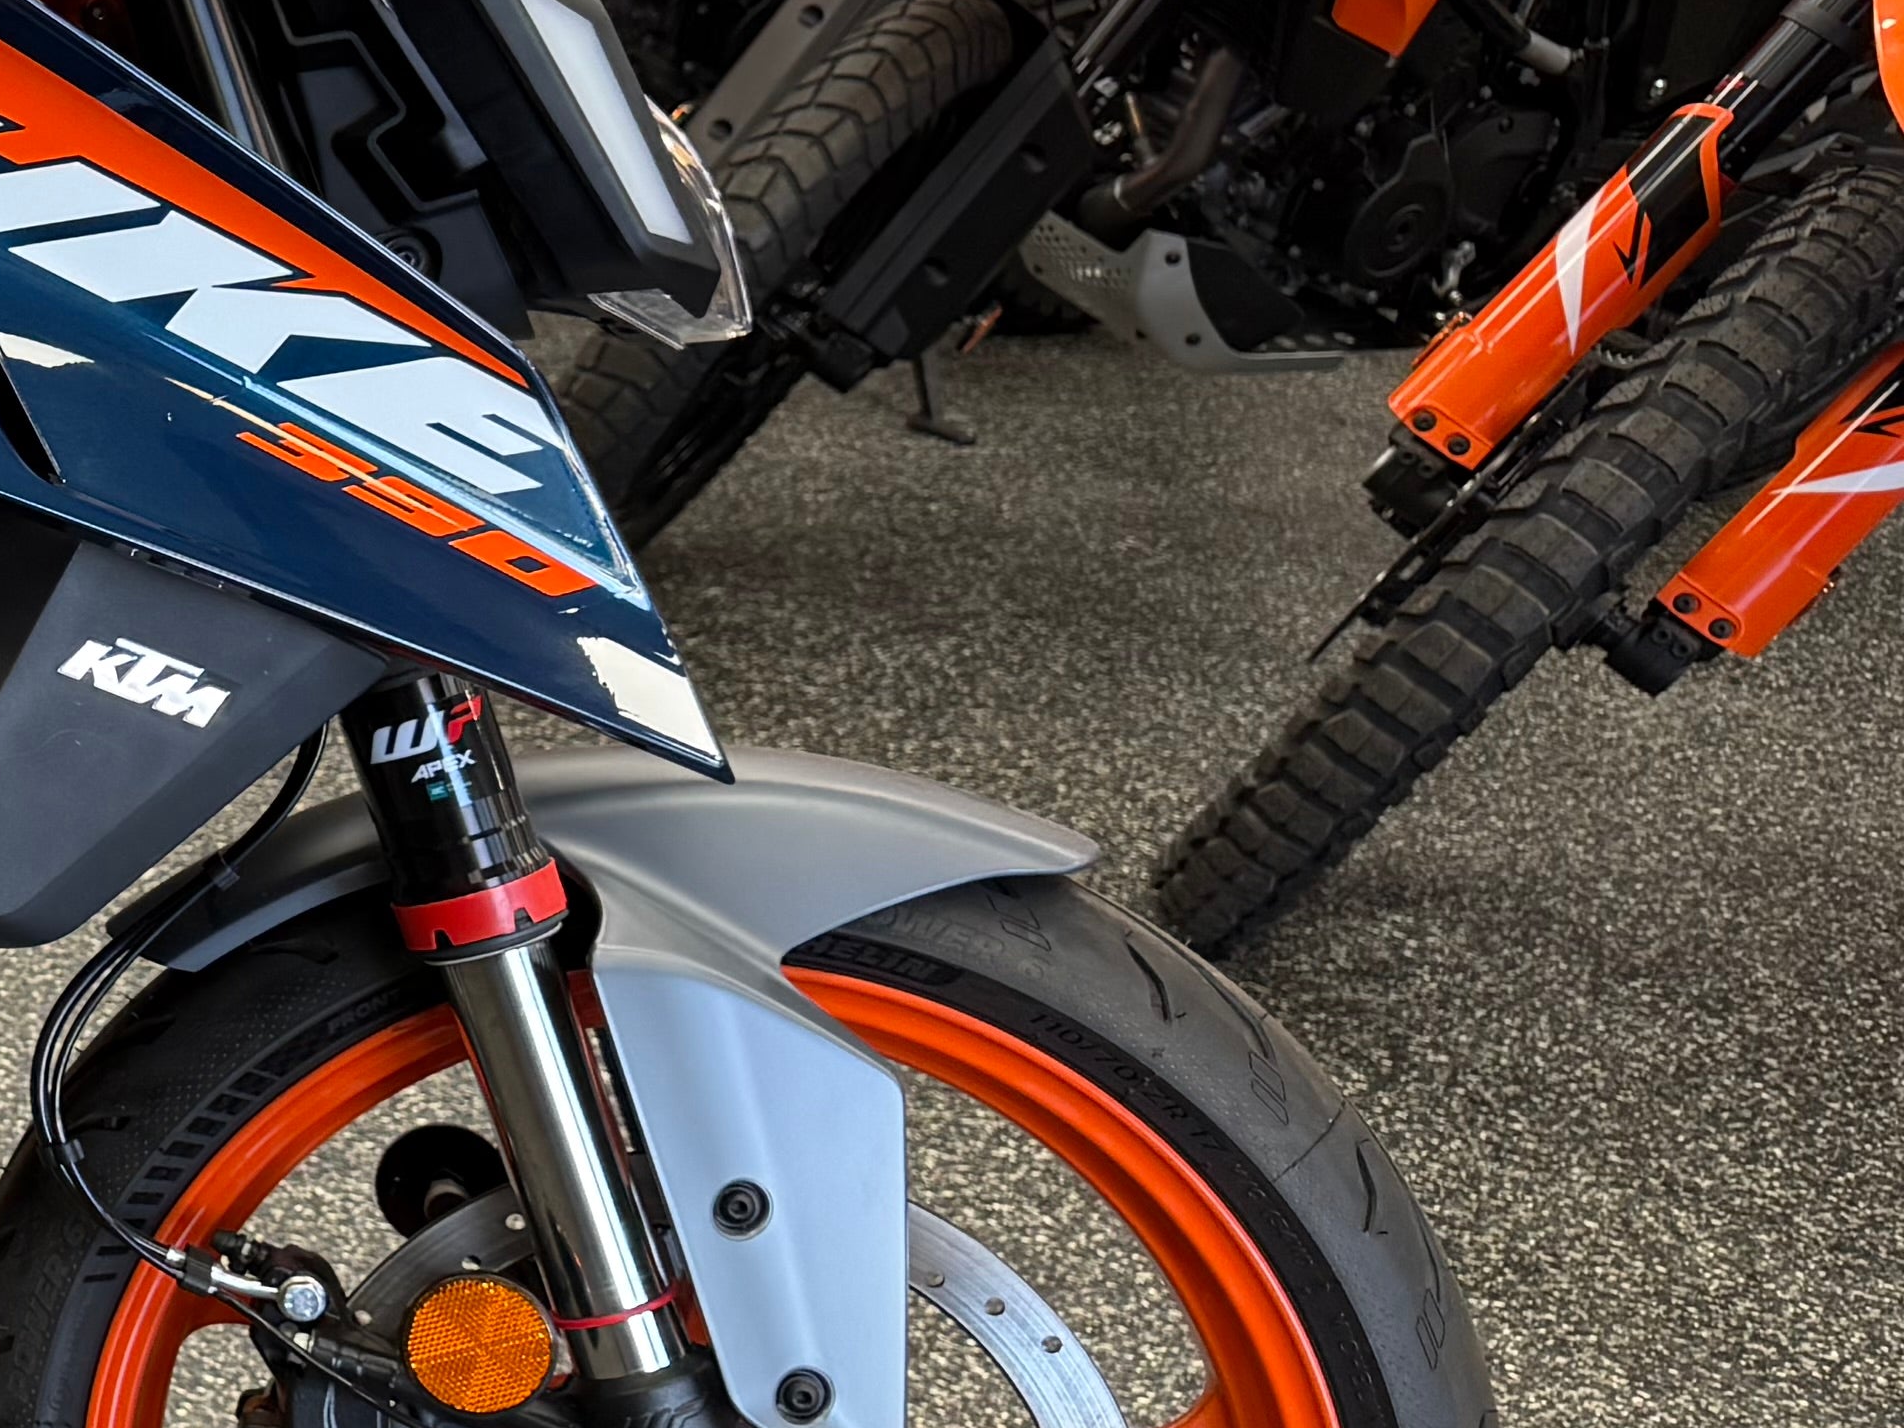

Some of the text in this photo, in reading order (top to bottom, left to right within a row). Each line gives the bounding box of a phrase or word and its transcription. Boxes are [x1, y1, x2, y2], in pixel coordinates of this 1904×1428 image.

[236, 422, 599, 597] 390
[56, 635, 232, 729] KTM
[370, 693, 483, 765] WP
[411, 749, 476, 783] APEX
